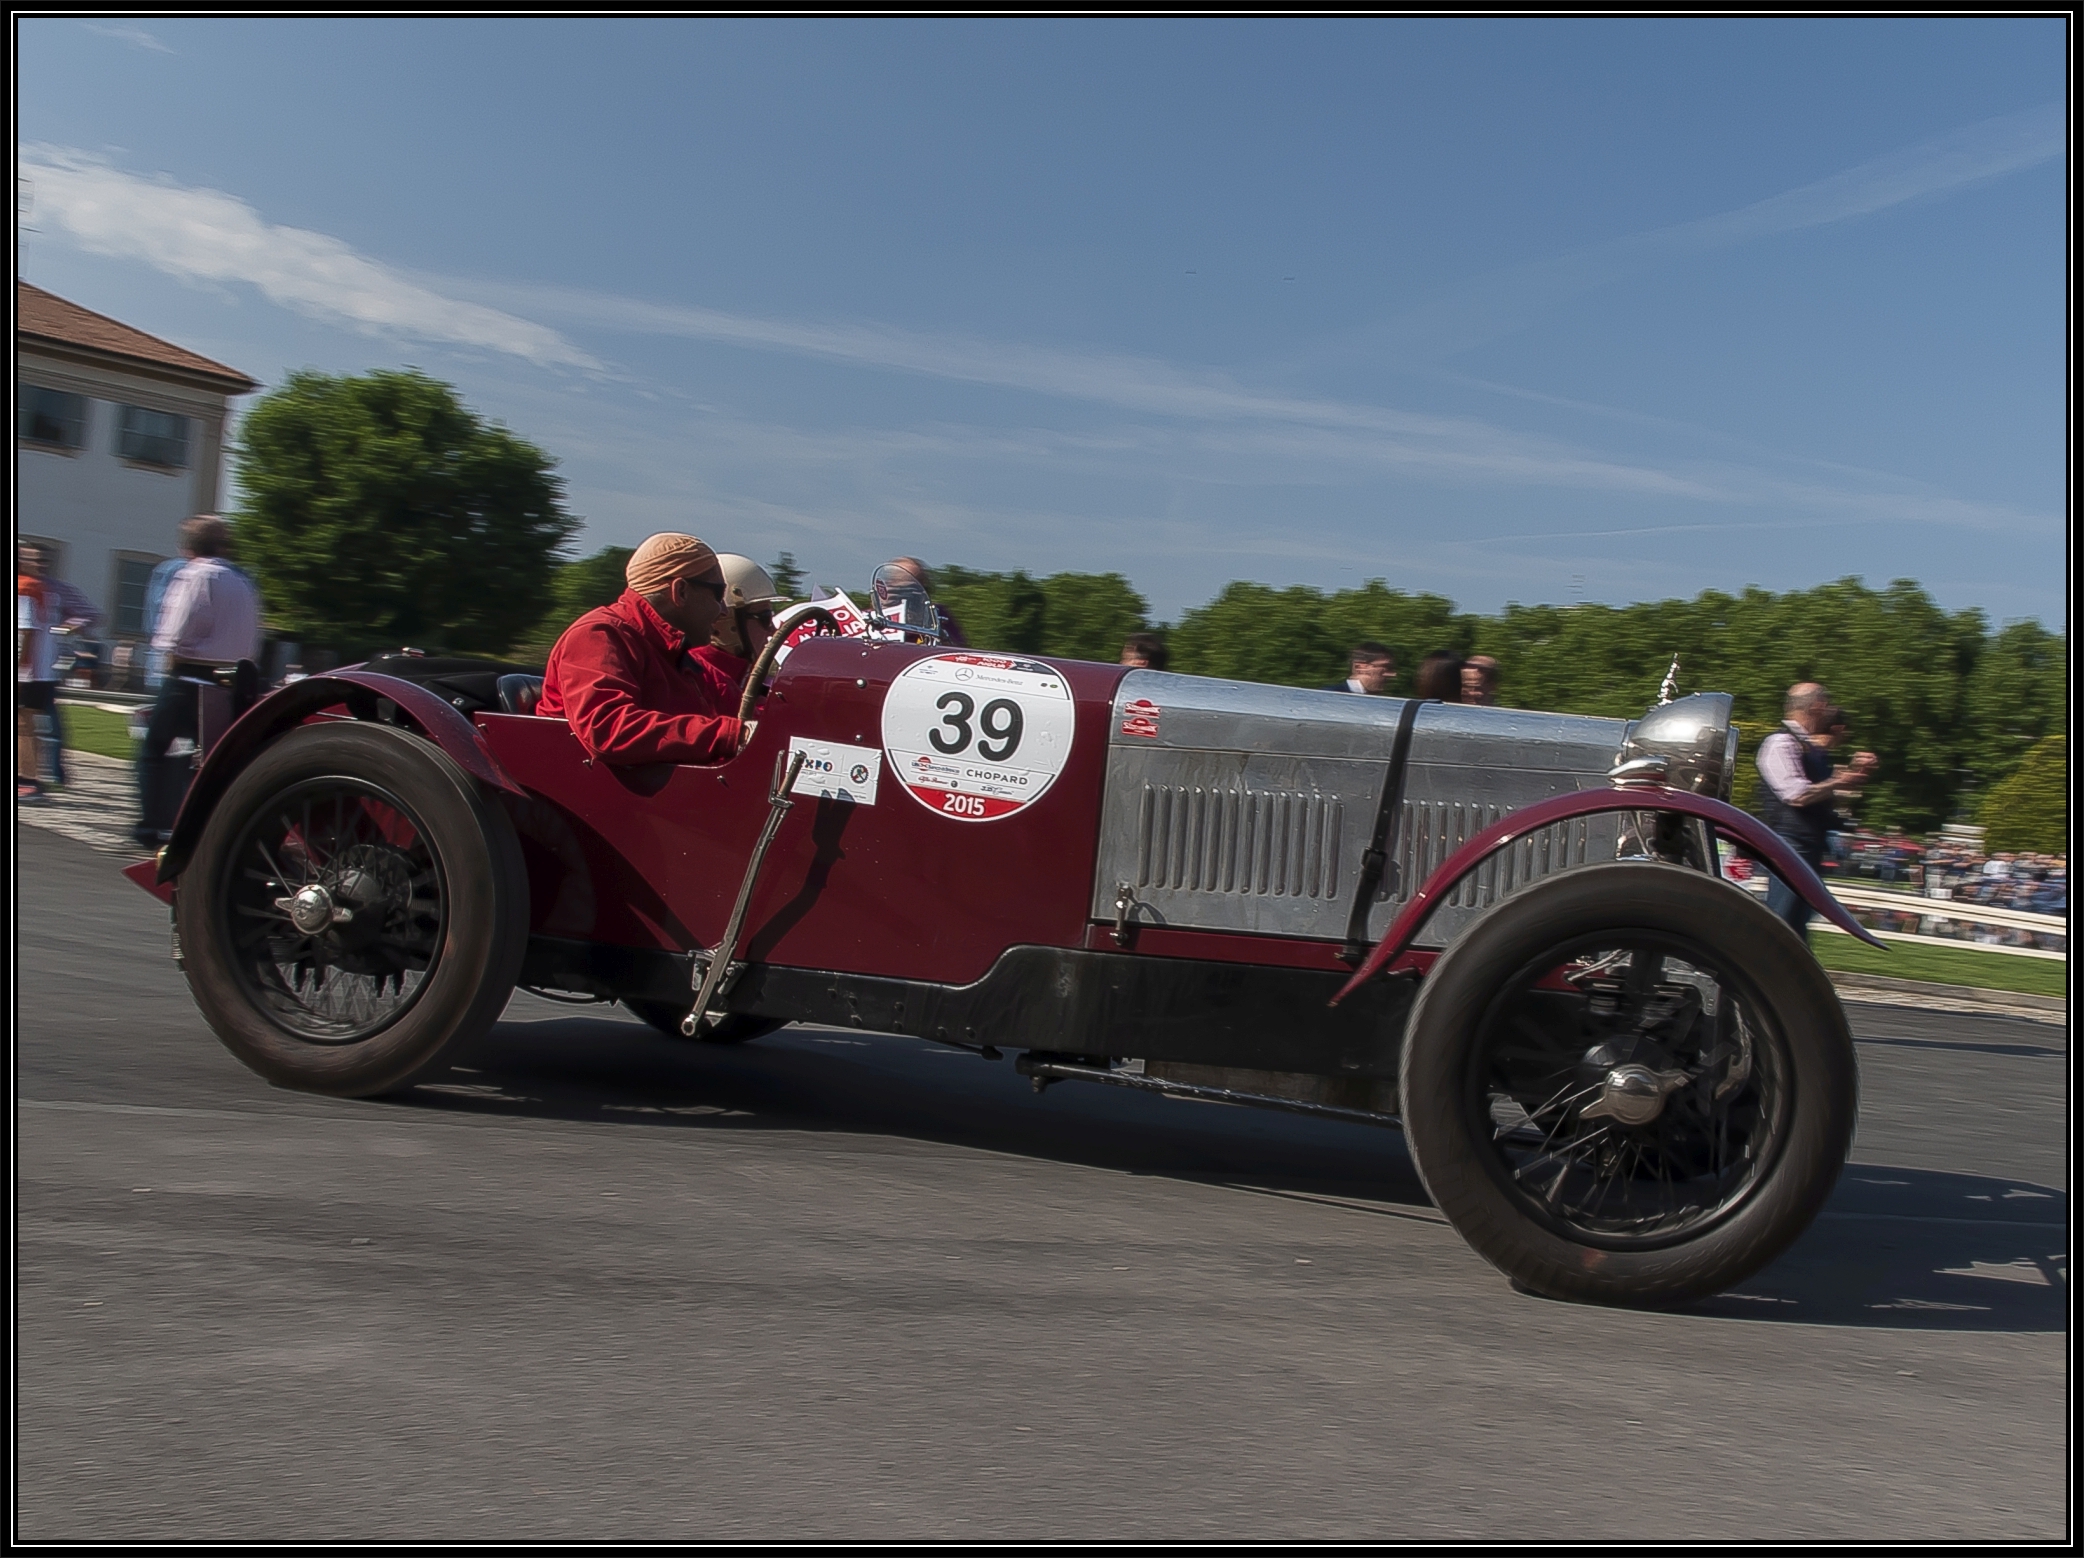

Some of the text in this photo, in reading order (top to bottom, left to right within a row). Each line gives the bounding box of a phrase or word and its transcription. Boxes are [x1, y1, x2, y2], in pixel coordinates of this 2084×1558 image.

[928, 691, 1024, 762] 39
[801, 759, 833, 773] XPO
[966, 769, 1028, 785] CHOPARD
[943, 793, 986, 816] 2015
